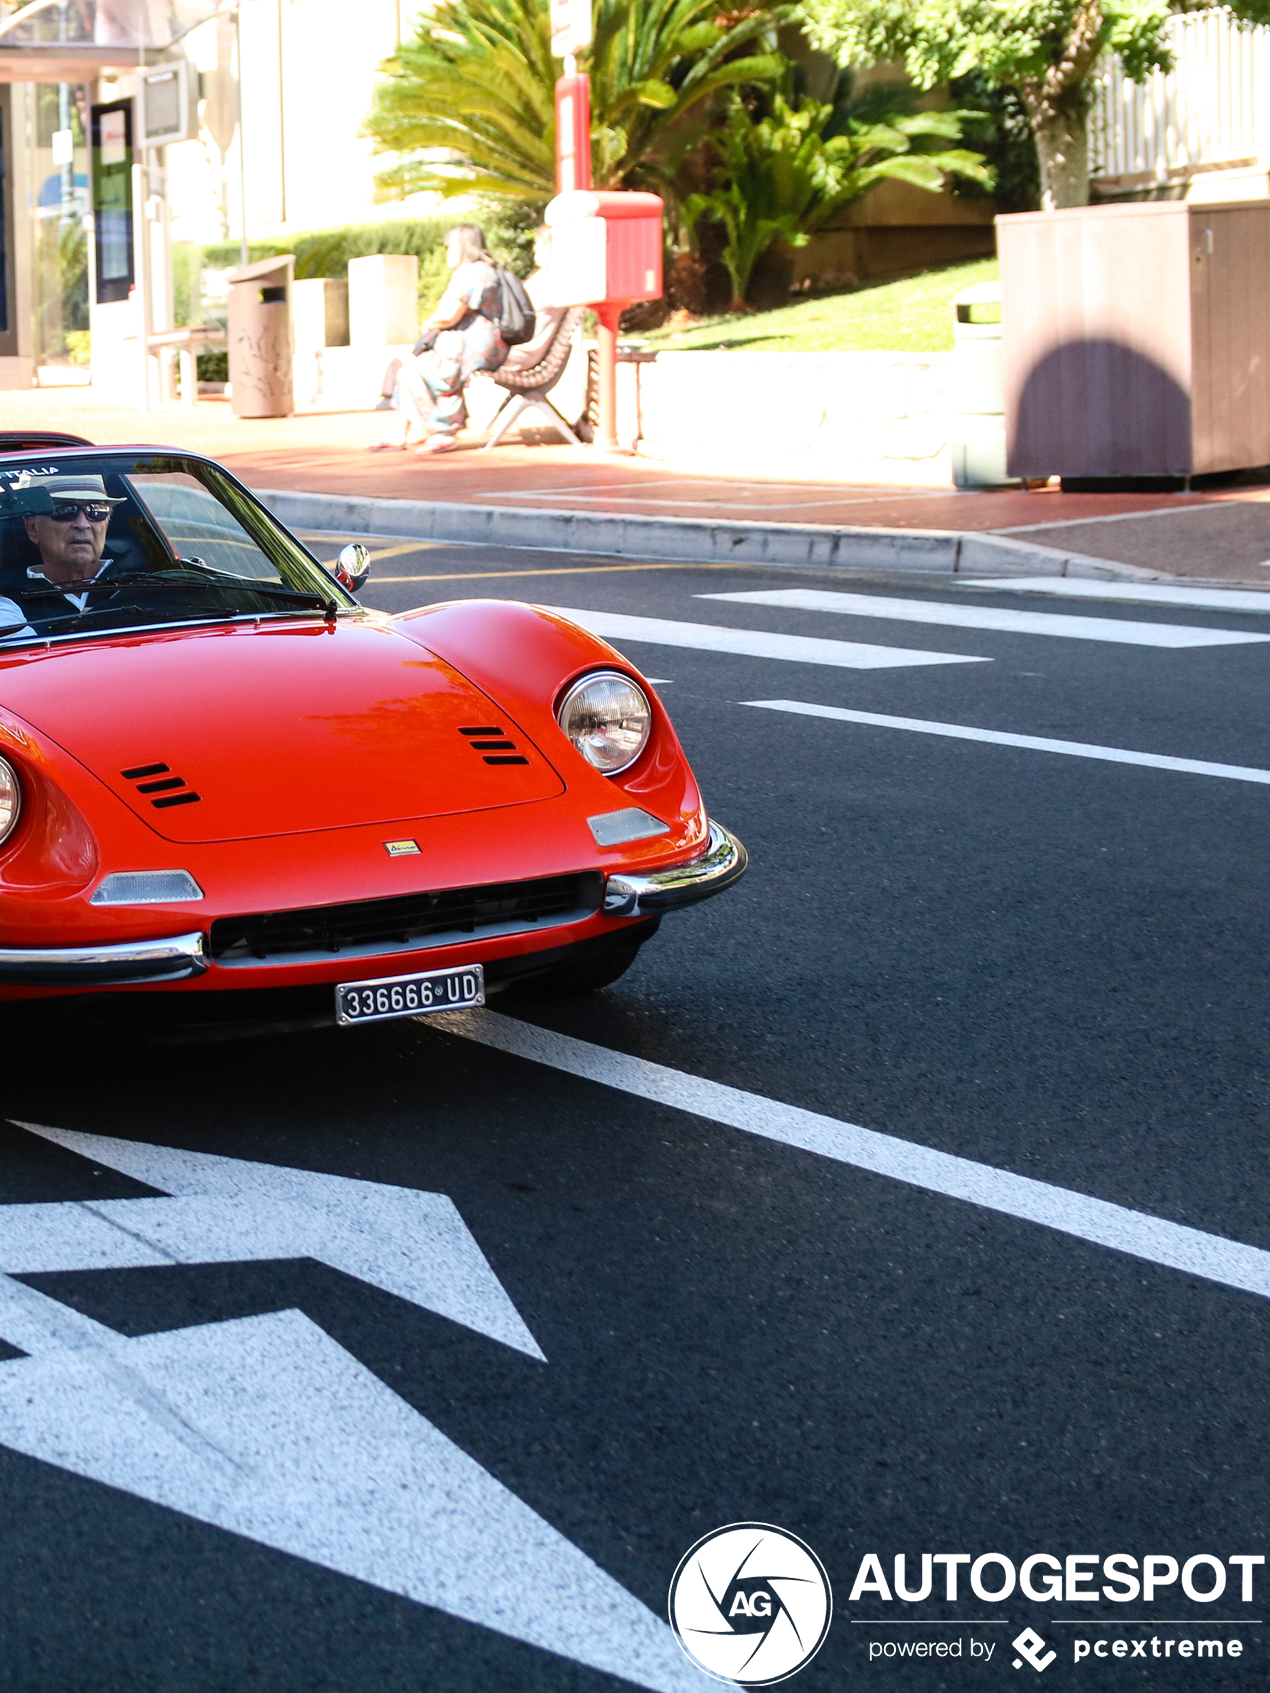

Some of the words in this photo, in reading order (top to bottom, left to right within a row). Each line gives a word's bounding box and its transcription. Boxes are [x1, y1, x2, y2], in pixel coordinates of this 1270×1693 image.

[4, 466, 59, 479] ITALIA
[346, 981, 434, 1016] 336666
[447, 974, 476, 1002] UD
